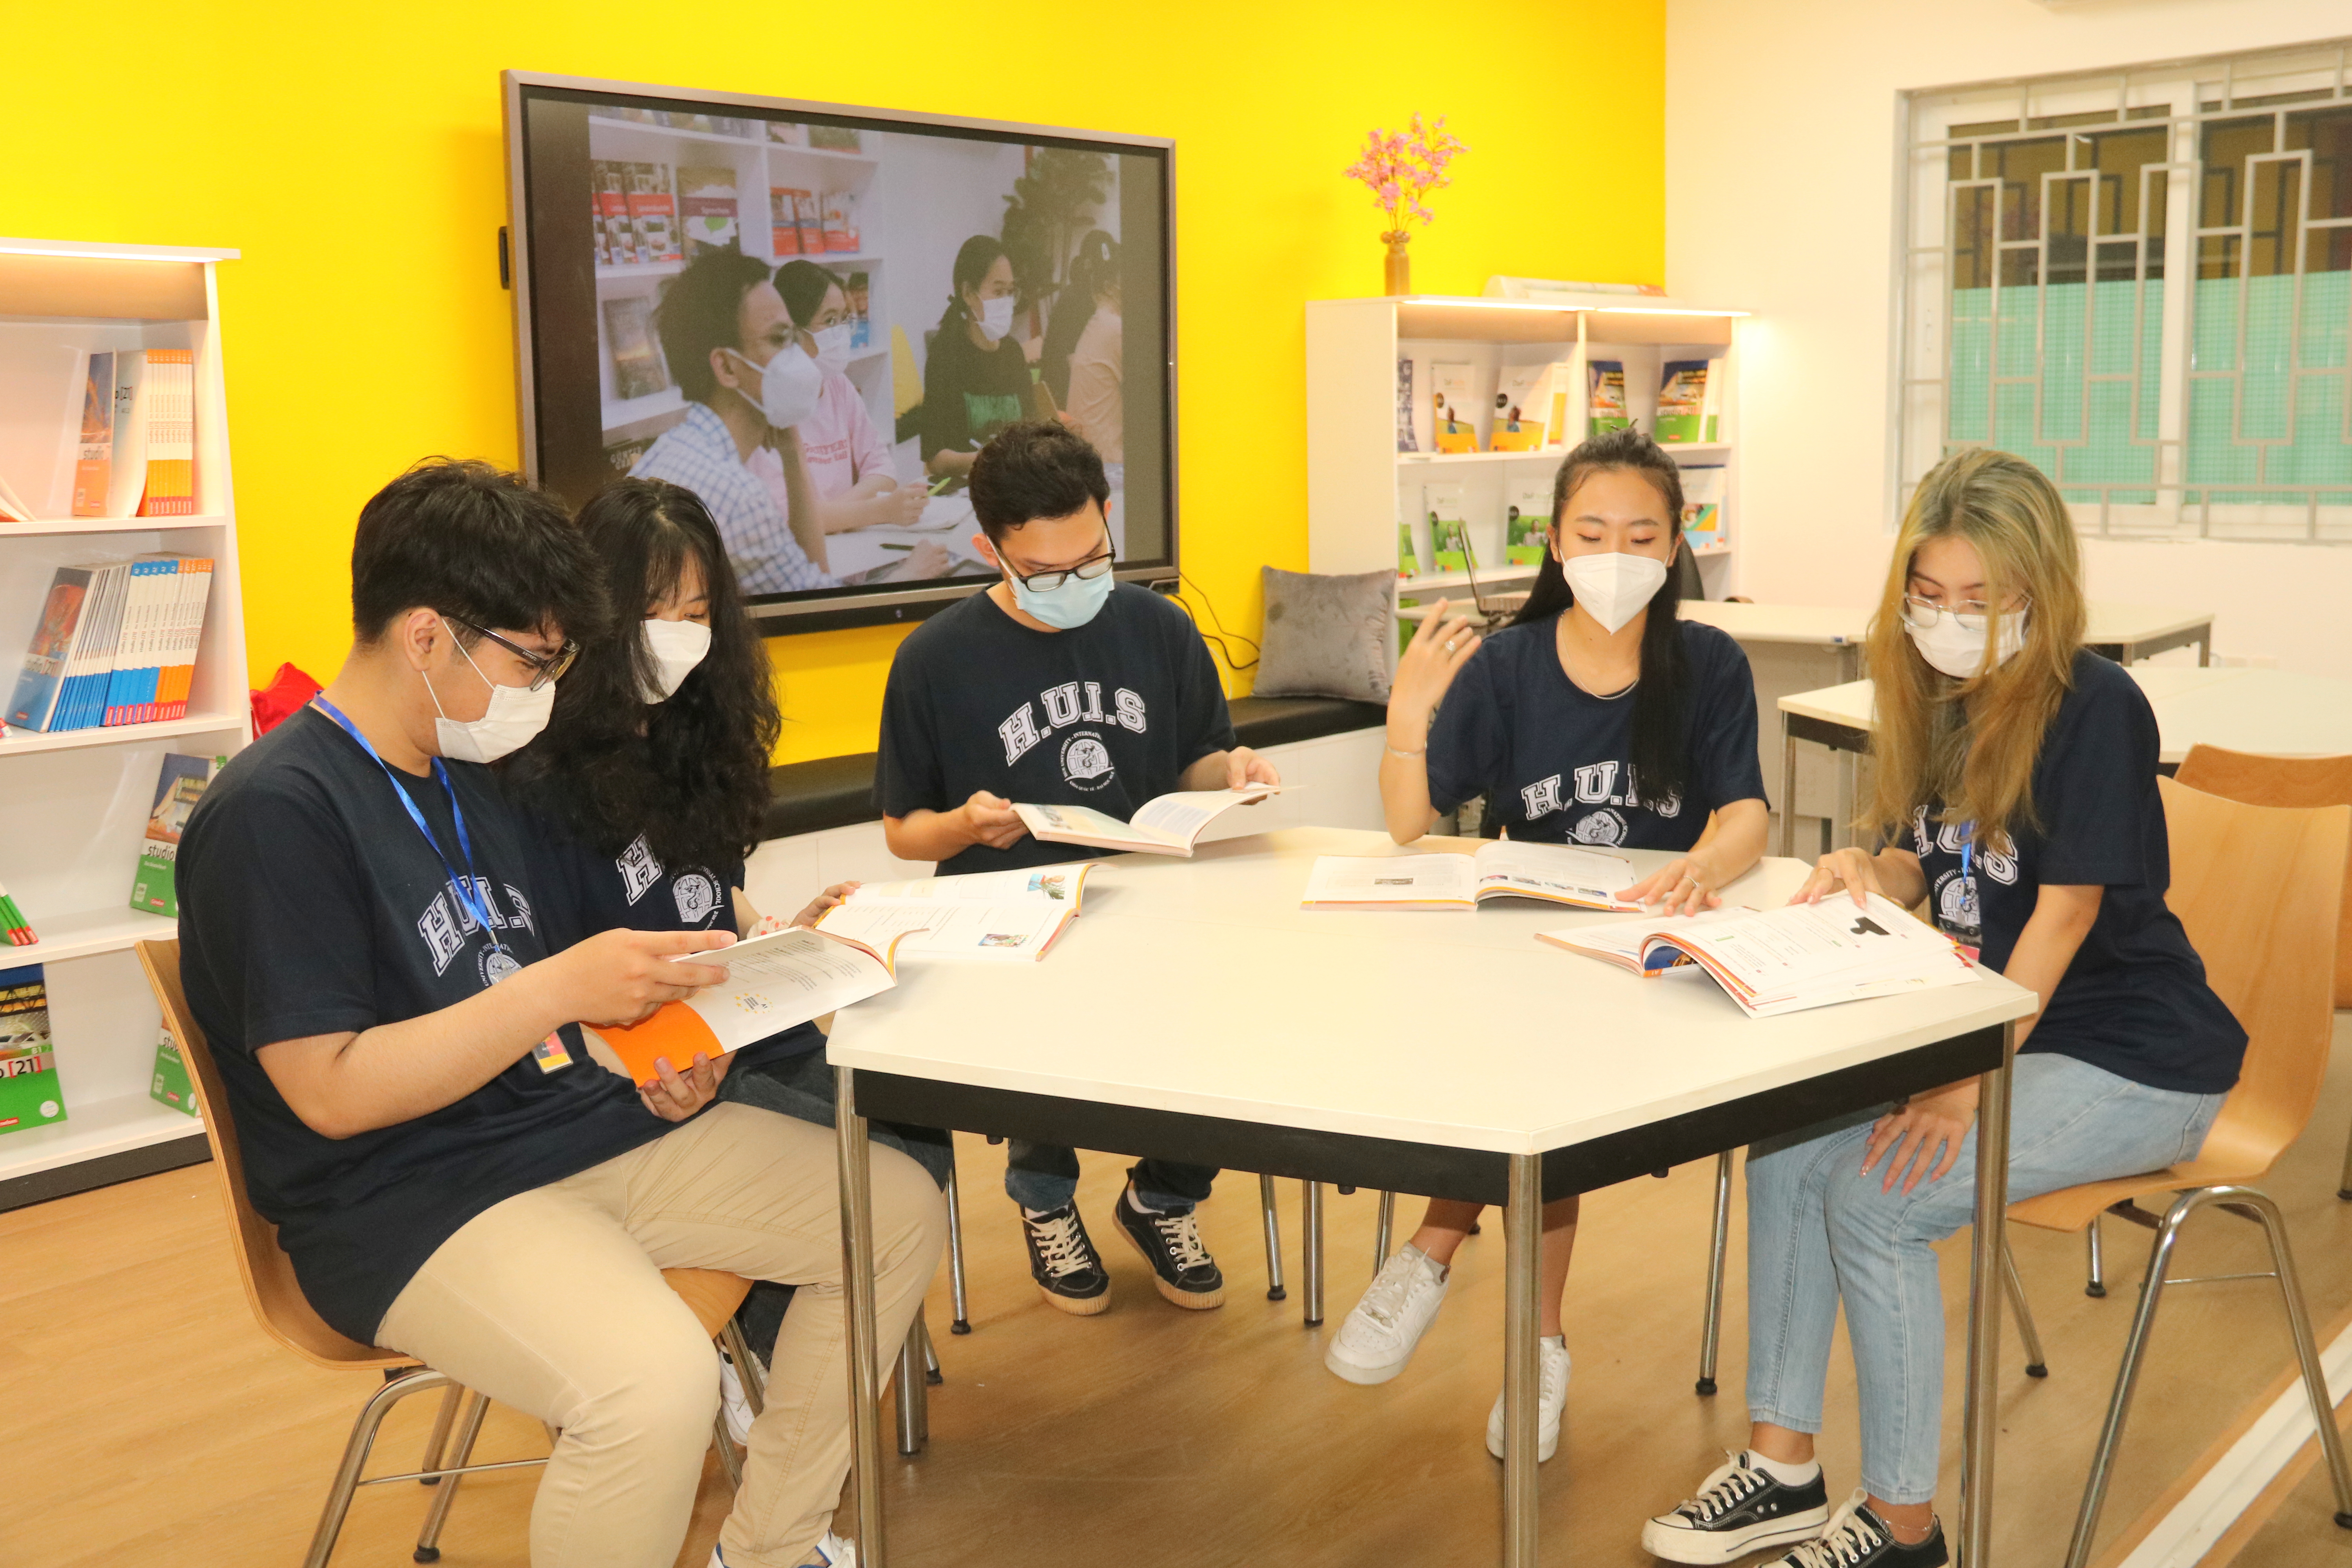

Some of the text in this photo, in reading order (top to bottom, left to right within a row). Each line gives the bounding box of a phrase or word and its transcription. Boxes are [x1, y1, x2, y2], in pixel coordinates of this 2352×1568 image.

[998, 681, 1147, 767] H.U.I.S
[1060, 737, 1072, 766] UNIVERSITY
[1073, 731, 1102, 740] INTERNATI
[148, 845, 175, 860] studio
[713, 880, 722, 905] SCHOOL
[478, 950, 489, 987] UNIVERSITY
[8, 1056, 42, 1078] [21]
